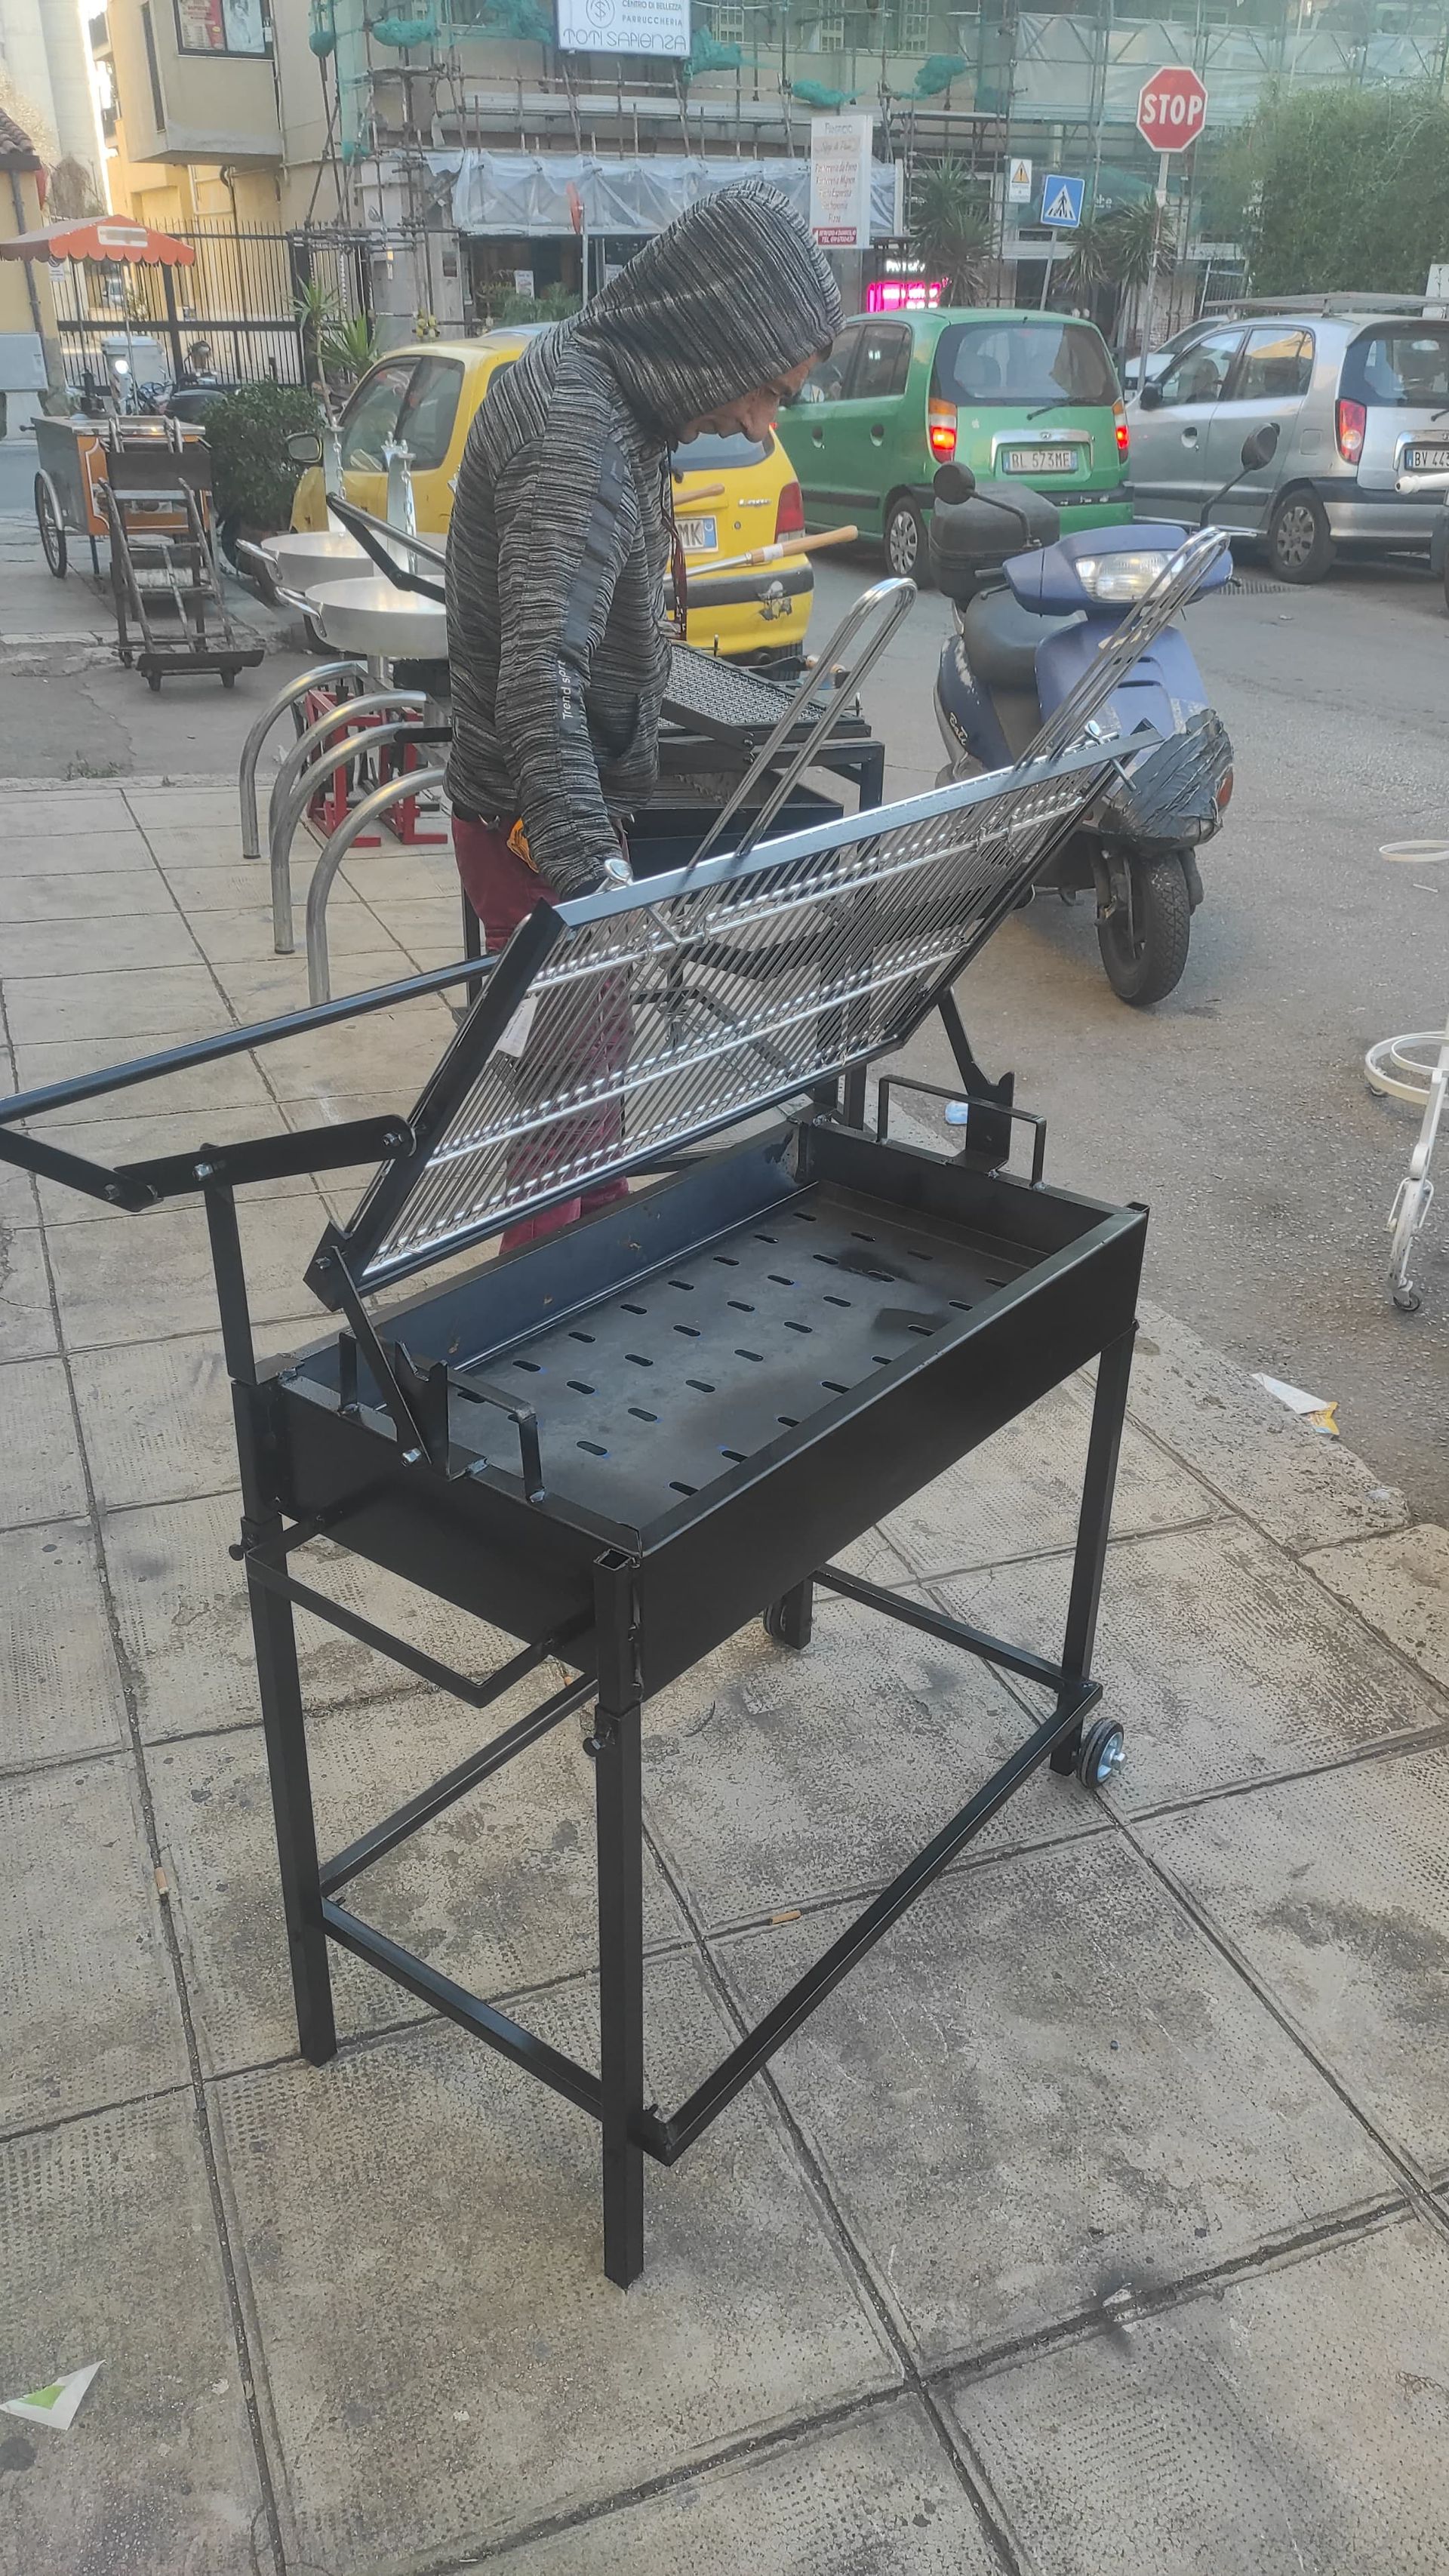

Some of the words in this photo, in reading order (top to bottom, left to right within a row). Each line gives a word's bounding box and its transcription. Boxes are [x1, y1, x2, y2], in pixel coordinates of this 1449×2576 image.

[656, 2, 682, 11] BELLEZZA
[622, 14, 682, 27] PARRUCCHERIA
[563, 28, 603, 46] TOTI
[1142, 93, 1203, 126] STOP
[1012, 454, 1026, 468] BL
[1032, 452, 1069, 468] 573ME
[1414, 451, 1428, 466] BV
[557, 660, 572, 684] sprt
[560, 686, 574, 720] Trend
